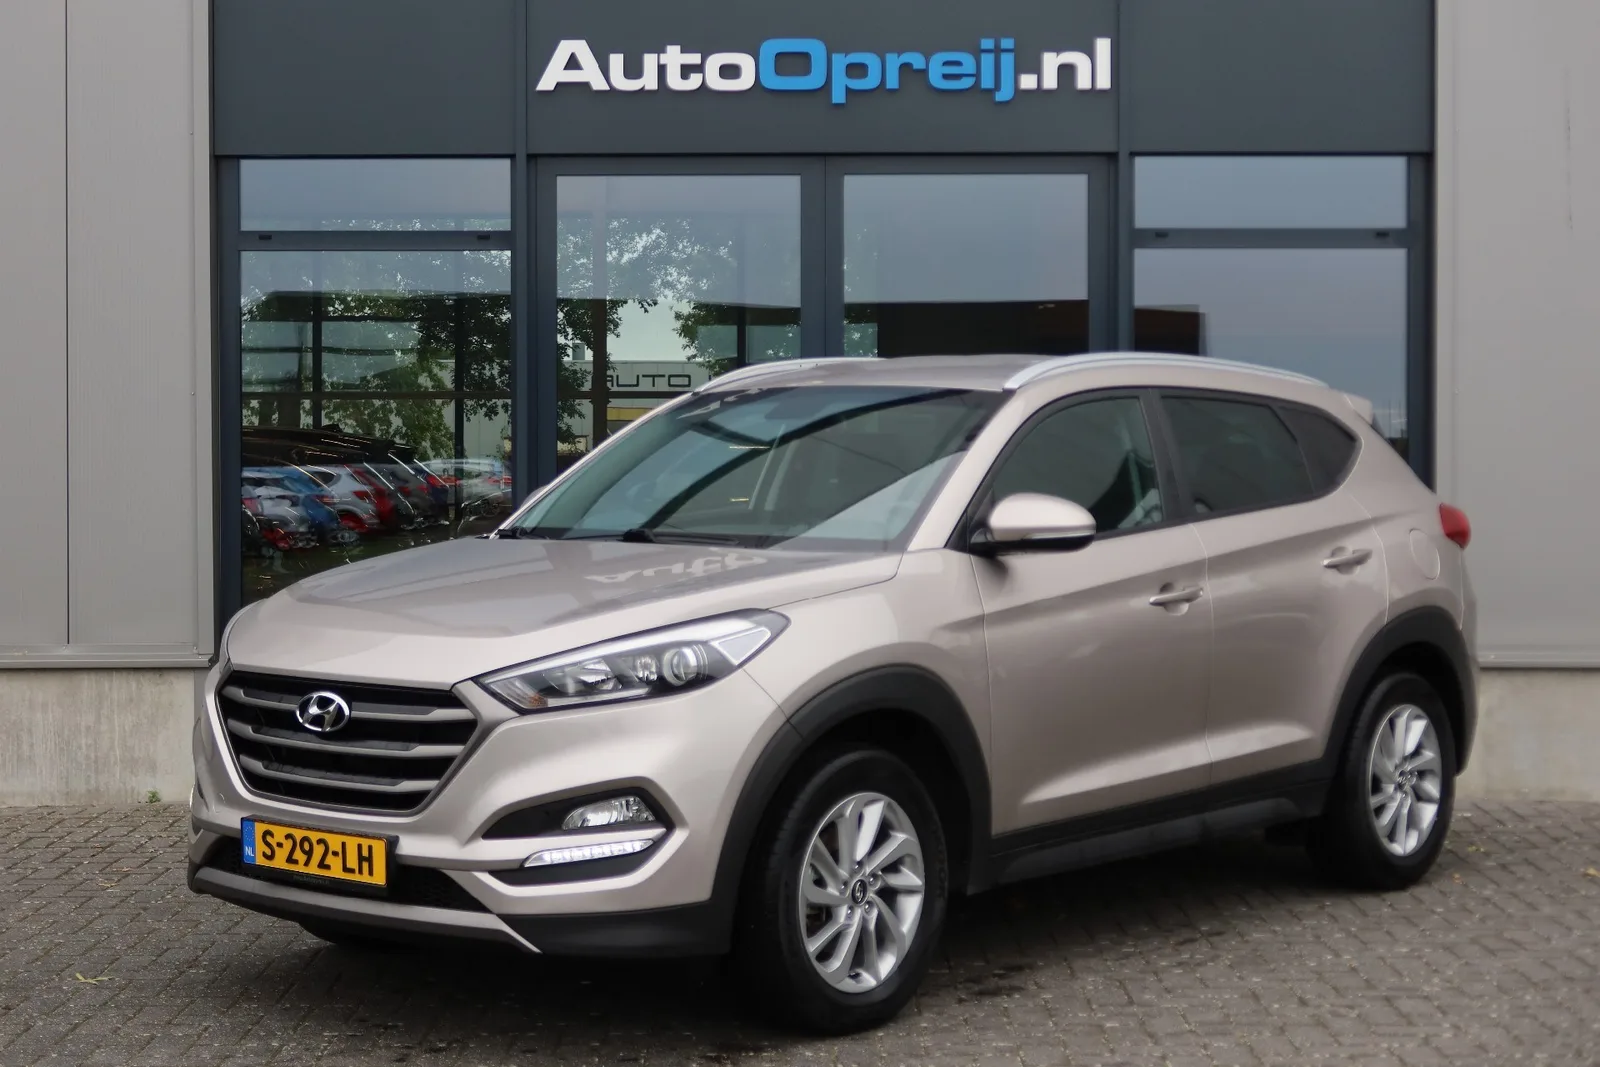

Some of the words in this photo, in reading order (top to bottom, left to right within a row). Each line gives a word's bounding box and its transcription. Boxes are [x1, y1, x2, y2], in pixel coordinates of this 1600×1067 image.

[535, 37, 1112, 104] AutoOpreij.nl
[245, 847, 255, 857] NL
[261, 829, 374, 877] S-292-LH
